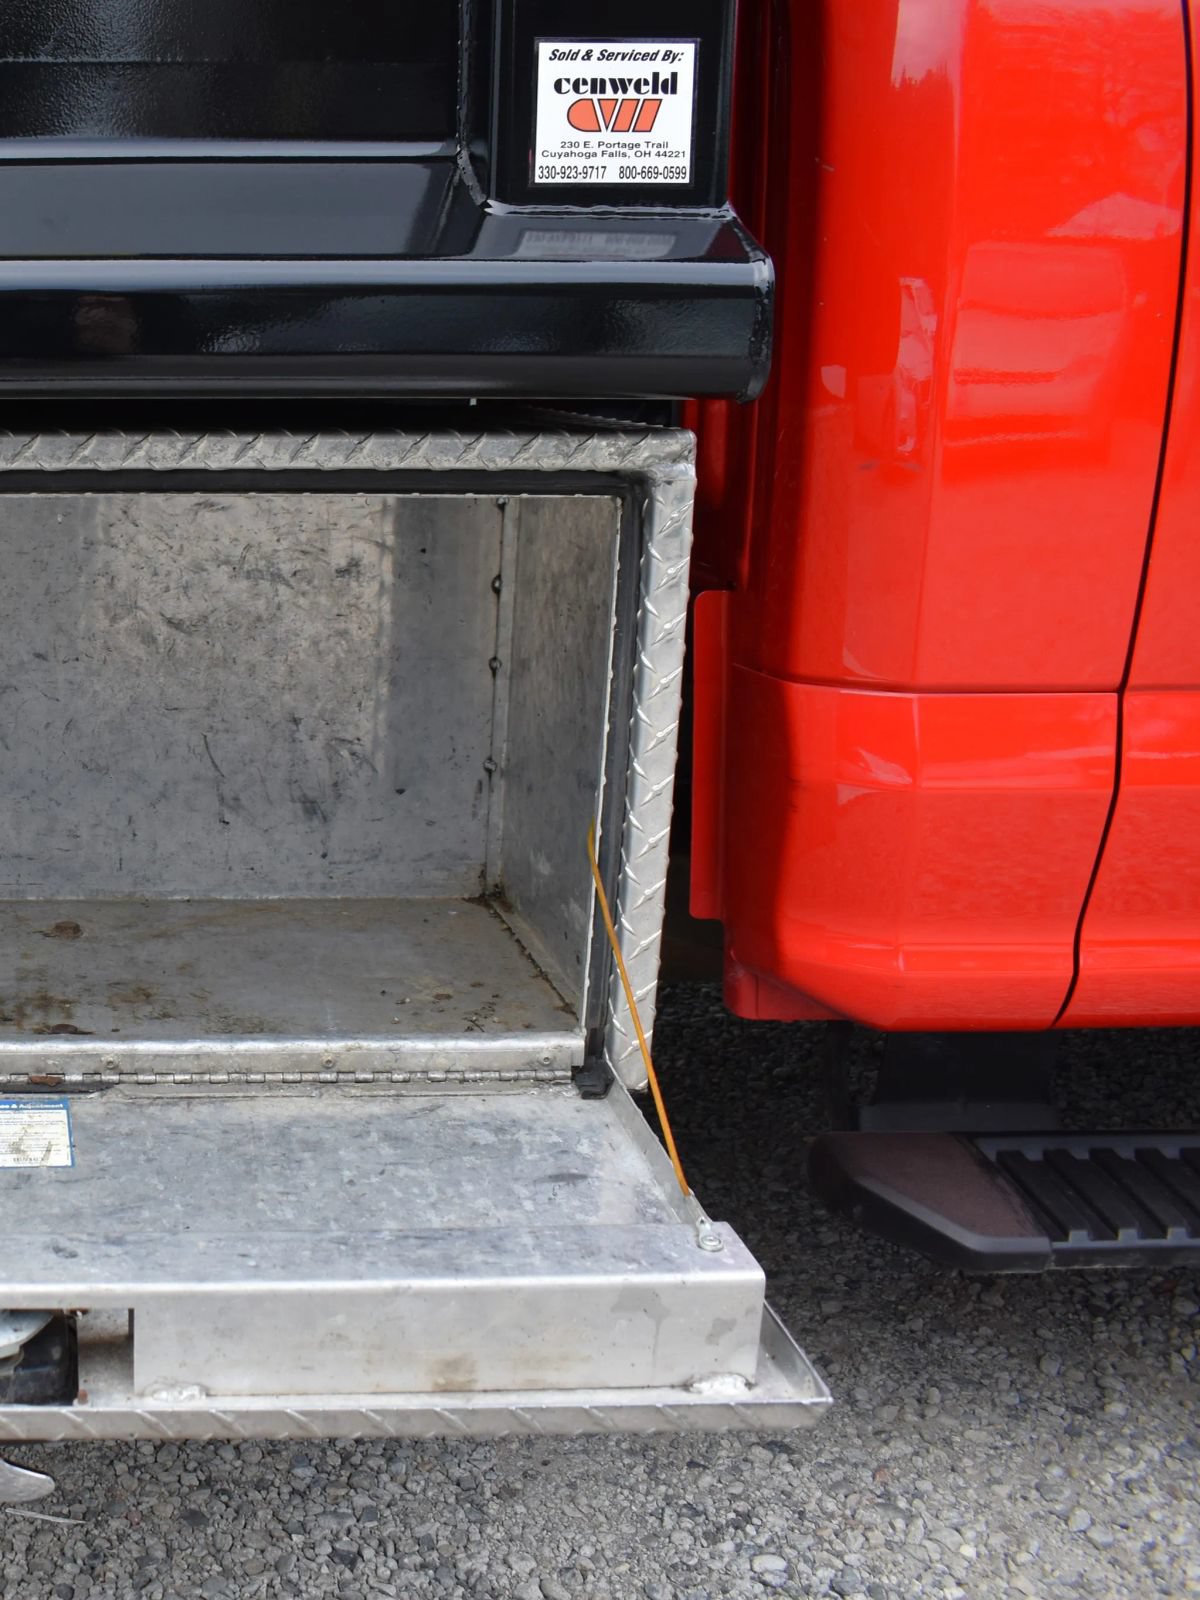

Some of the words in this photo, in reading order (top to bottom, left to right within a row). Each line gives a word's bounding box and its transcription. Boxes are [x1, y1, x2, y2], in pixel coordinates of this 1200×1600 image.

[548, 49, 580, 62] Sold
[581, 49, 594, 62] &
[597, 49, 659, 62] Serviced
[661, 50, 685, 64] By:
[553, 71, 679, 95] cenweld
[560, 141, 580, 149] 230
[583, 141, 594, 149] E.
[597, 141, 641, 150] Portage
[644, 141, 669, 149] Trail
[541, 150, 598, 159] Cuyahoga
[601, 150, 631, 159] Falls,
[538, 165, 607, 180] 330-923-9717
[618, 165, 687, 180] 800-669-0599
